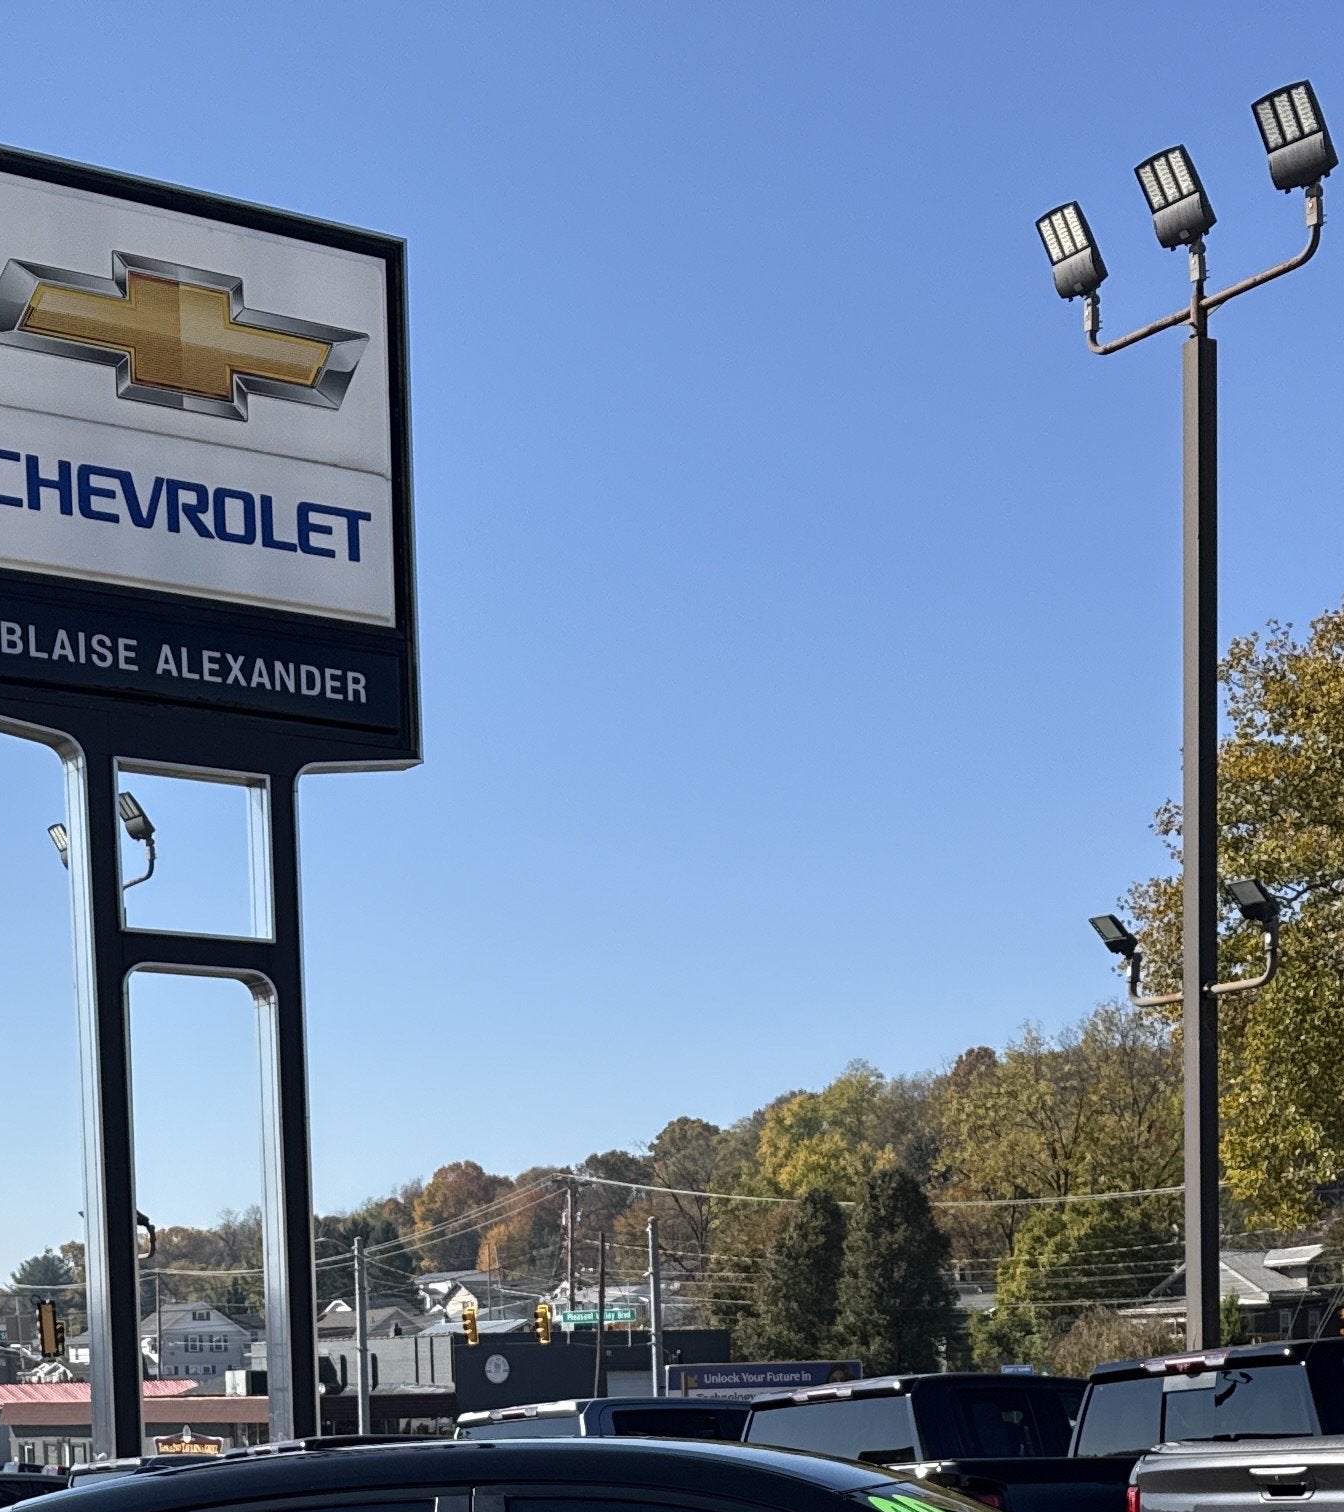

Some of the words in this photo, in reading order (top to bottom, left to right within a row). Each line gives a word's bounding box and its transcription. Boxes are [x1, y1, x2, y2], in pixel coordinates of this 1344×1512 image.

[0, 620, 140, 673] BLAISE
[155, 642, 368, 704] ALEXANDER
[703, 1372, 740, 1384] Unlock
[741, 1372, 765, 1383] Your
[766, 1371, 800, 1382] Future
[801, 1370, 812, 1381] in
